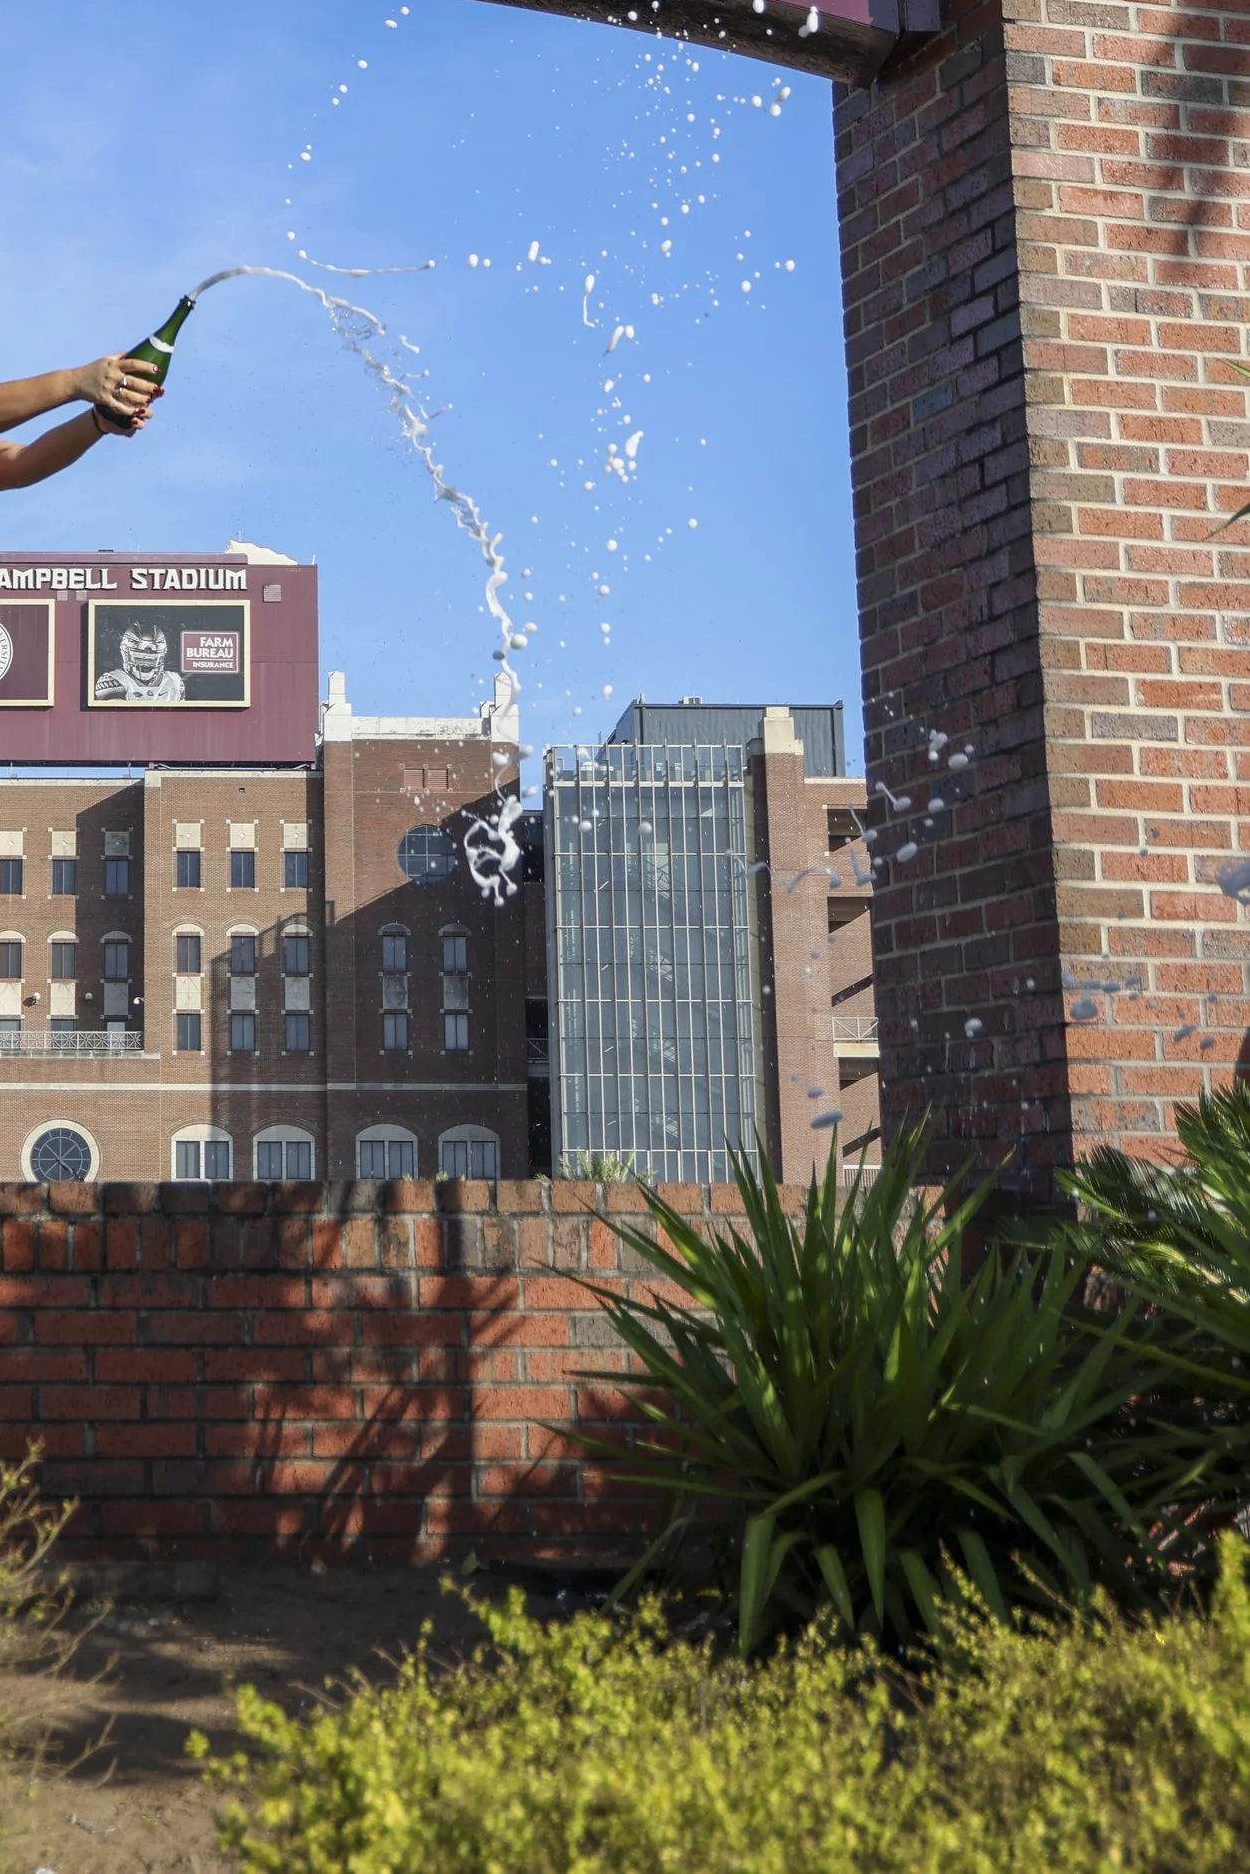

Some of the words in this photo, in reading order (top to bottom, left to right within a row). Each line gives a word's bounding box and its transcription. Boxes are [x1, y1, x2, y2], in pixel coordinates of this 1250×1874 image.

[131, 568, 248, 591] STADIUM
[200, 636, 234, 647] FARM
[186, 647, 234, 658] BUREAU
[192, 661, 234, 669] INSURANCE
